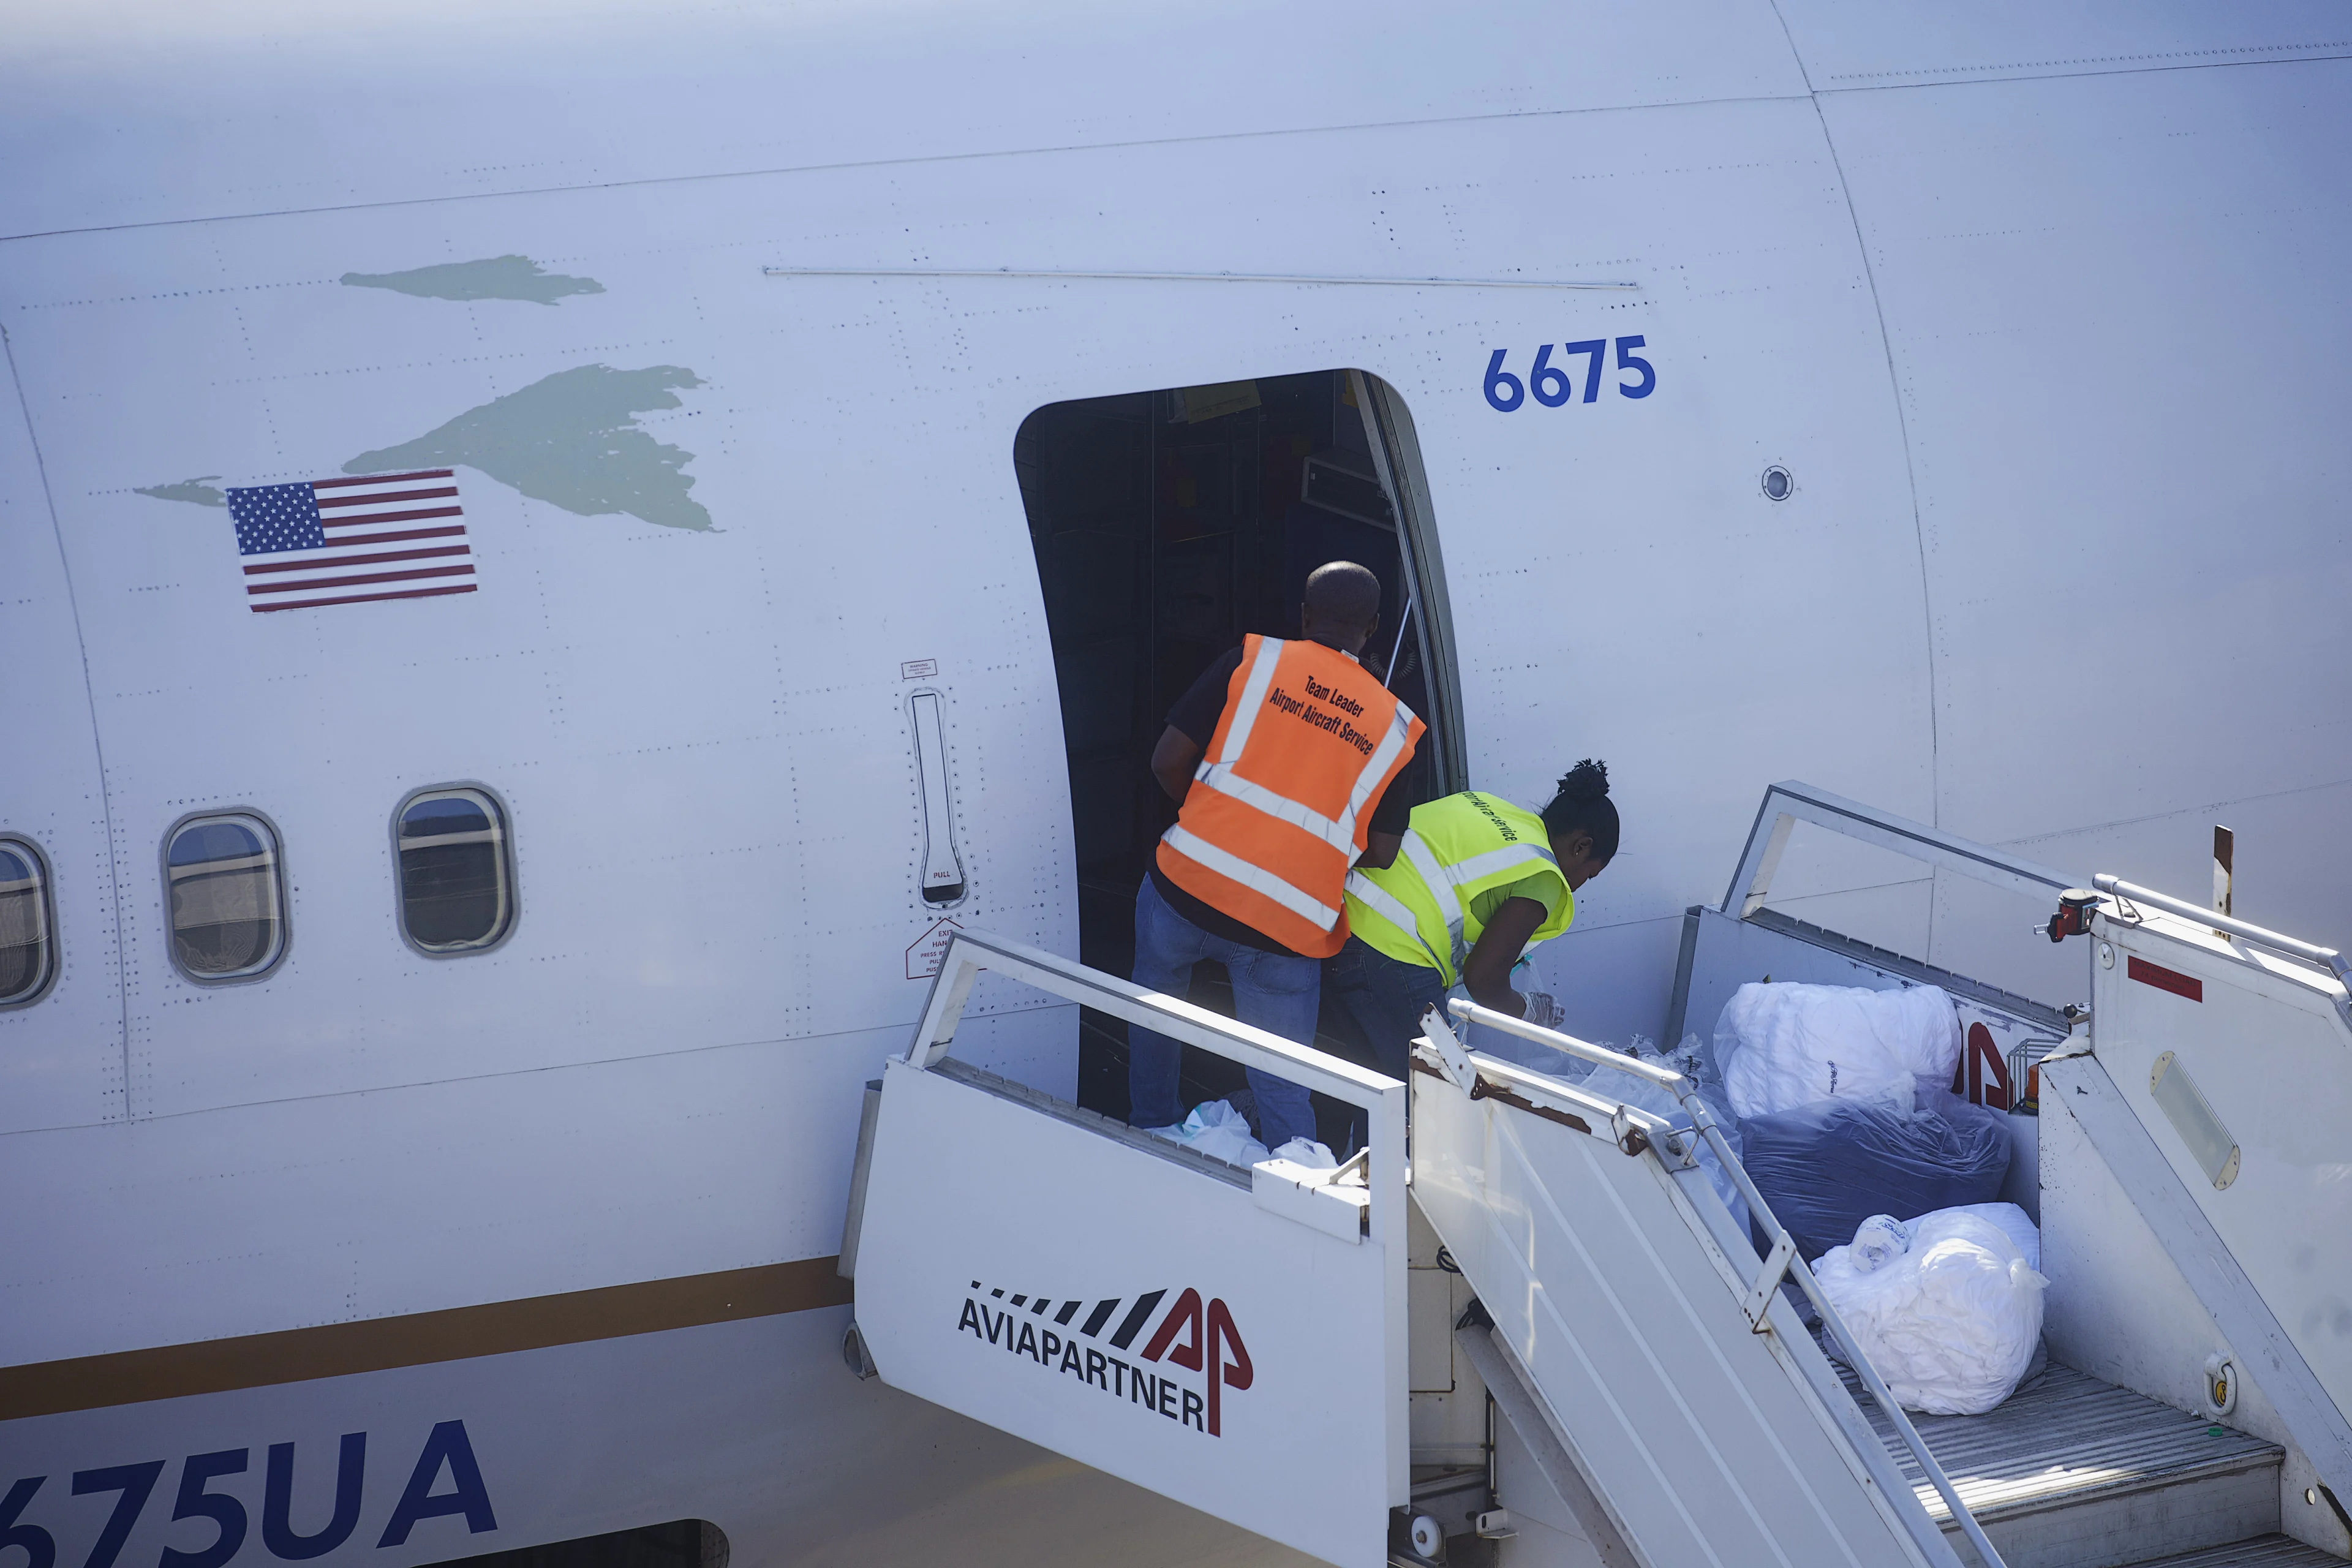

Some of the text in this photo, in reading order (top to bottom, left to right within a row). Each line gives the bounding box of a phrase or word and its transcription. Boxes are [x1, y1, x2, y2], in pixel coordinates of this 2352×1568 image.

[1483, 335, 1656, 412] 6675
[1269, 687, 1373, 756] Airport Aircraft Service
[1305, 675, 1364, 718] Team Leader
[2133, 960, 2196, 987] MAXIMUM LOAD
[958, 1298, 1204, 1433] AVIAPARTNER
